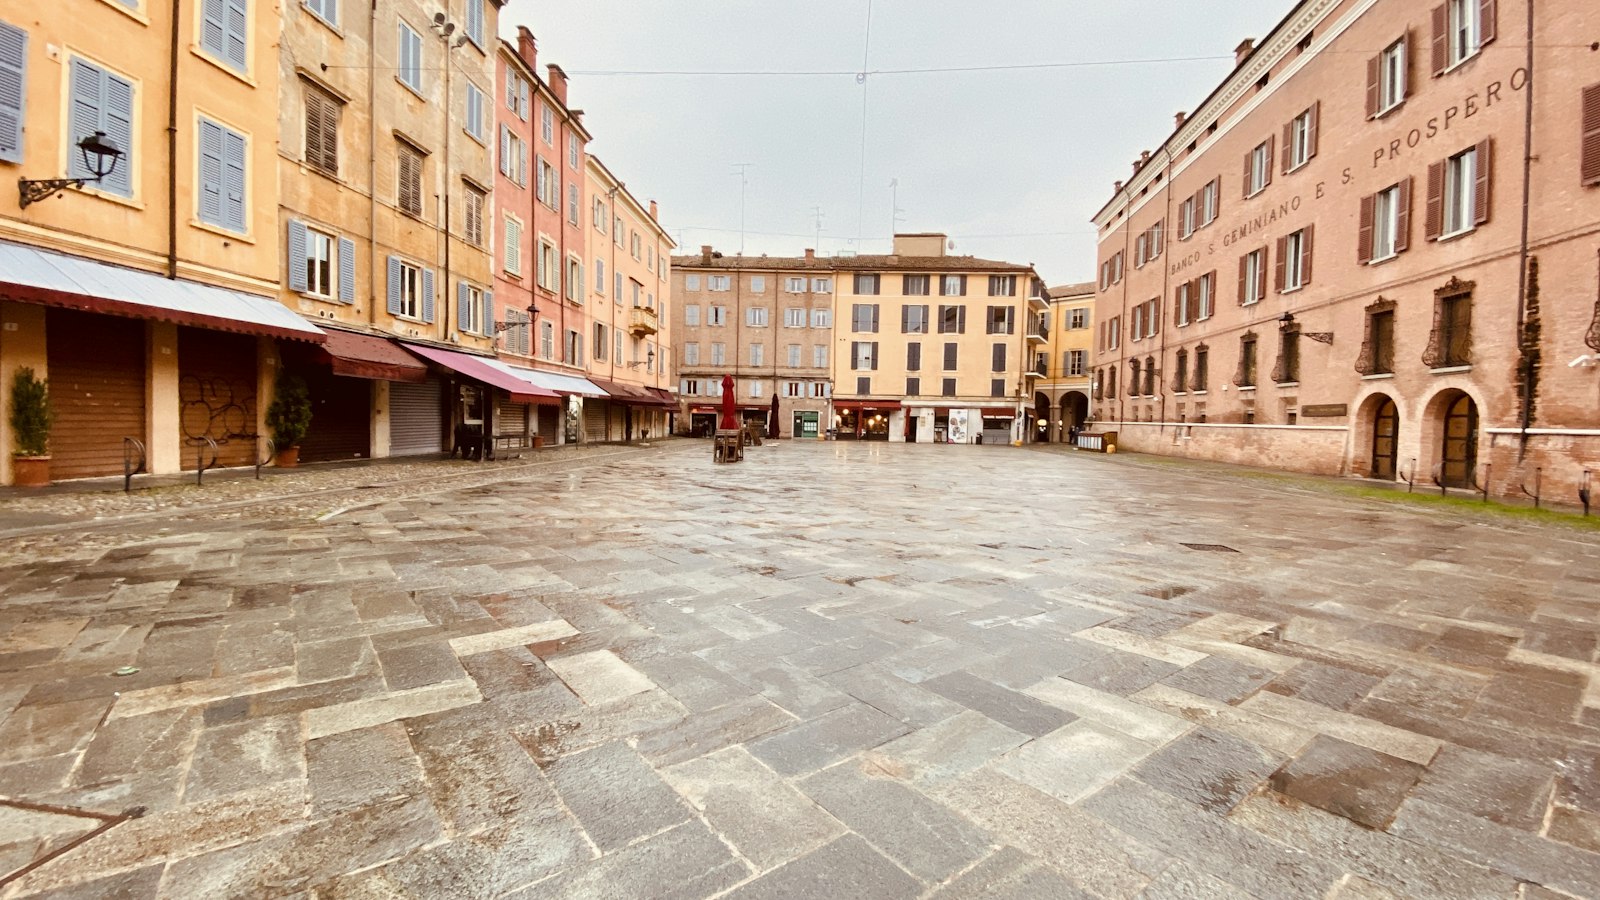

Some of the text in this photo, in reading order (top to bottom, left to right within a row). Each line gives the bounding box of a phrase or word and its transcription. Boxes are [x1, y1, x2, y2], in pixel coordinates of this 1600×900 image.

[1171, 251, 1200, 275] BANCO
[1223, 195, 1301, 247] GEMINIANO
[1315, 181, 1325, 199] E
[1372, 67, 1528, 168] PROSPERO
